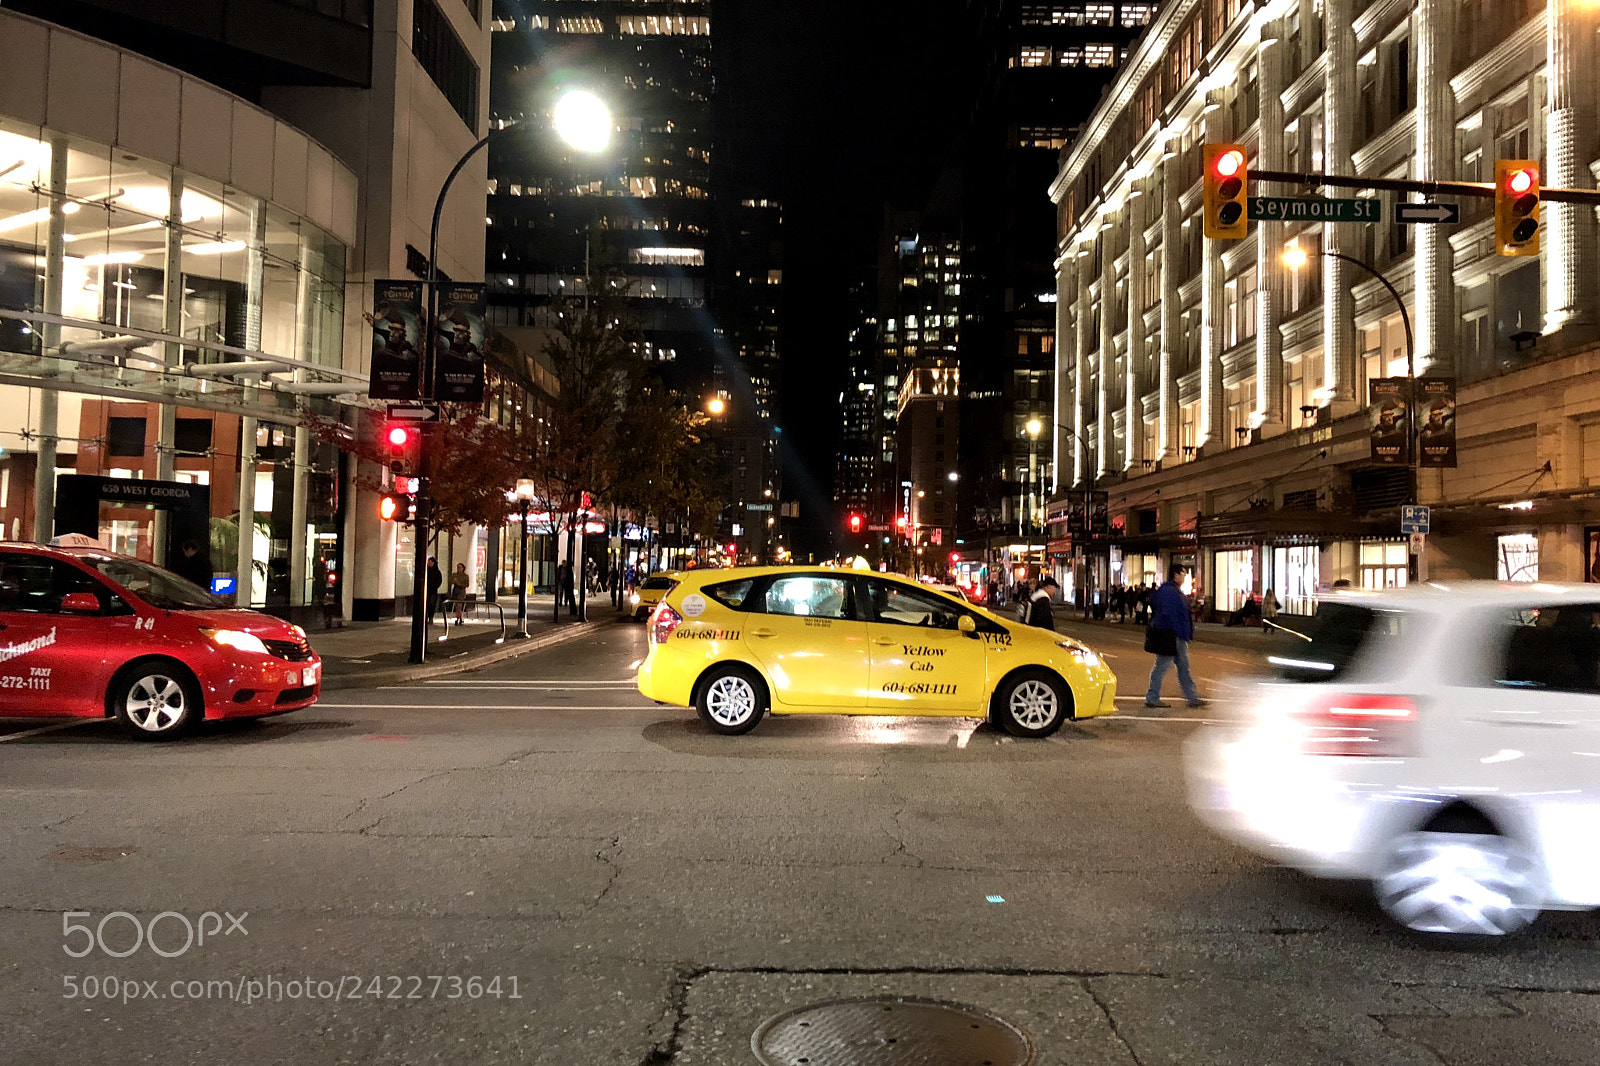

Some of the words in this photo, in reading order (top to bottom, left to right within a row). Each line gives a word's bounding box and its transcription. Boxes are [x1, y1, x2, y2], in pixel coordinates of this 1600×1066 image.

[1255, 199, 1344, 219] Seymour
[1354, 200, 1372, 217] St
[102, 484, 120, 494] 650
[122, 485, 147, 495] WEST
[150, 486, 191, 498] GEORGIA
[983, 632, 1013, 647] Y142
[903, 645, 947, 657] Yellow
[30, 667, 52, 677] TAXI
[909, 660, 934, 672] Cab
[882, 681, 957, 695] 604-681-1111
